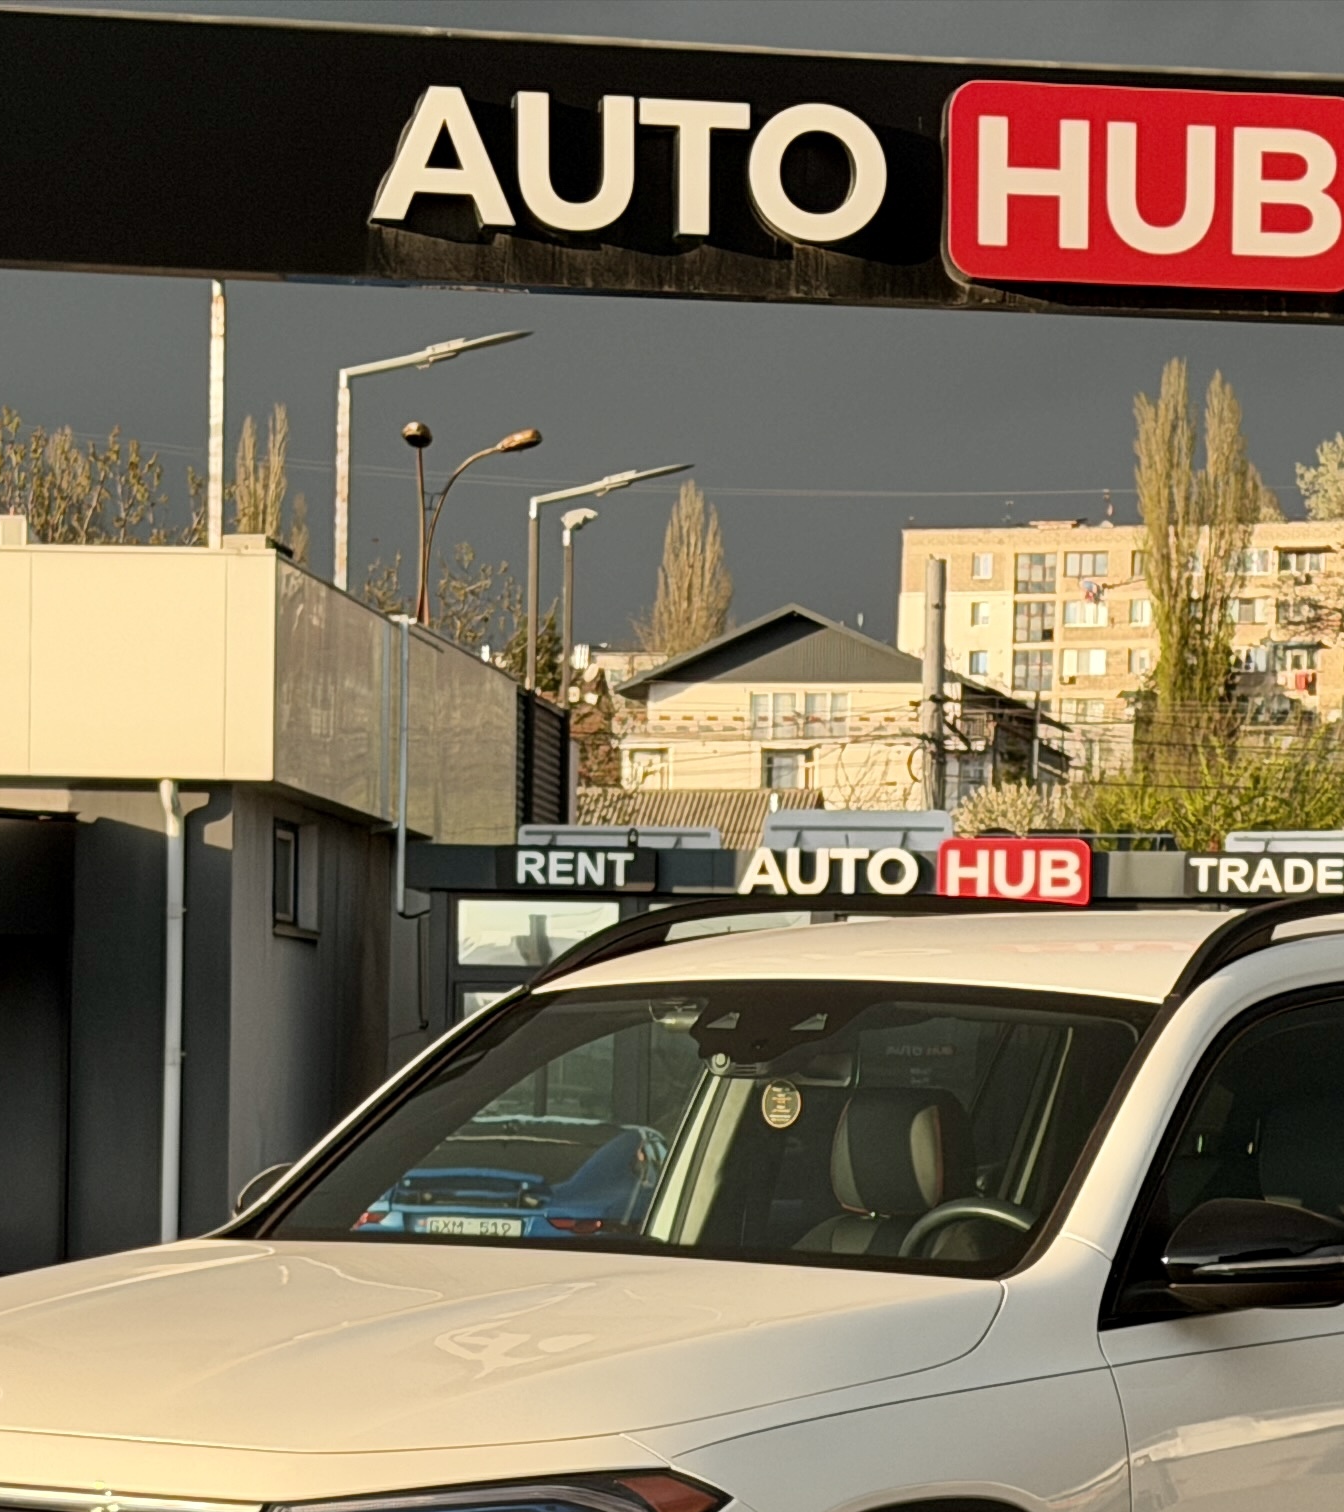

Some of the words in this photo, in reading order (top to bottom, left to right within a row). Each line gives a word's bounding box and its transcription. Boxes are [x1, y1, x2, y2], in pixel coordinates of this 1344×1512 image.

[369, 85, 888, 243] AUTO
[976, 114, 1343, 258] HUB
[516, 850, 635, 887] RENT
[737, 846, 919, 896] AUTO
[945, 848, 1082, 898] HUB
[1188, 857, 1344, 894] TRADE
